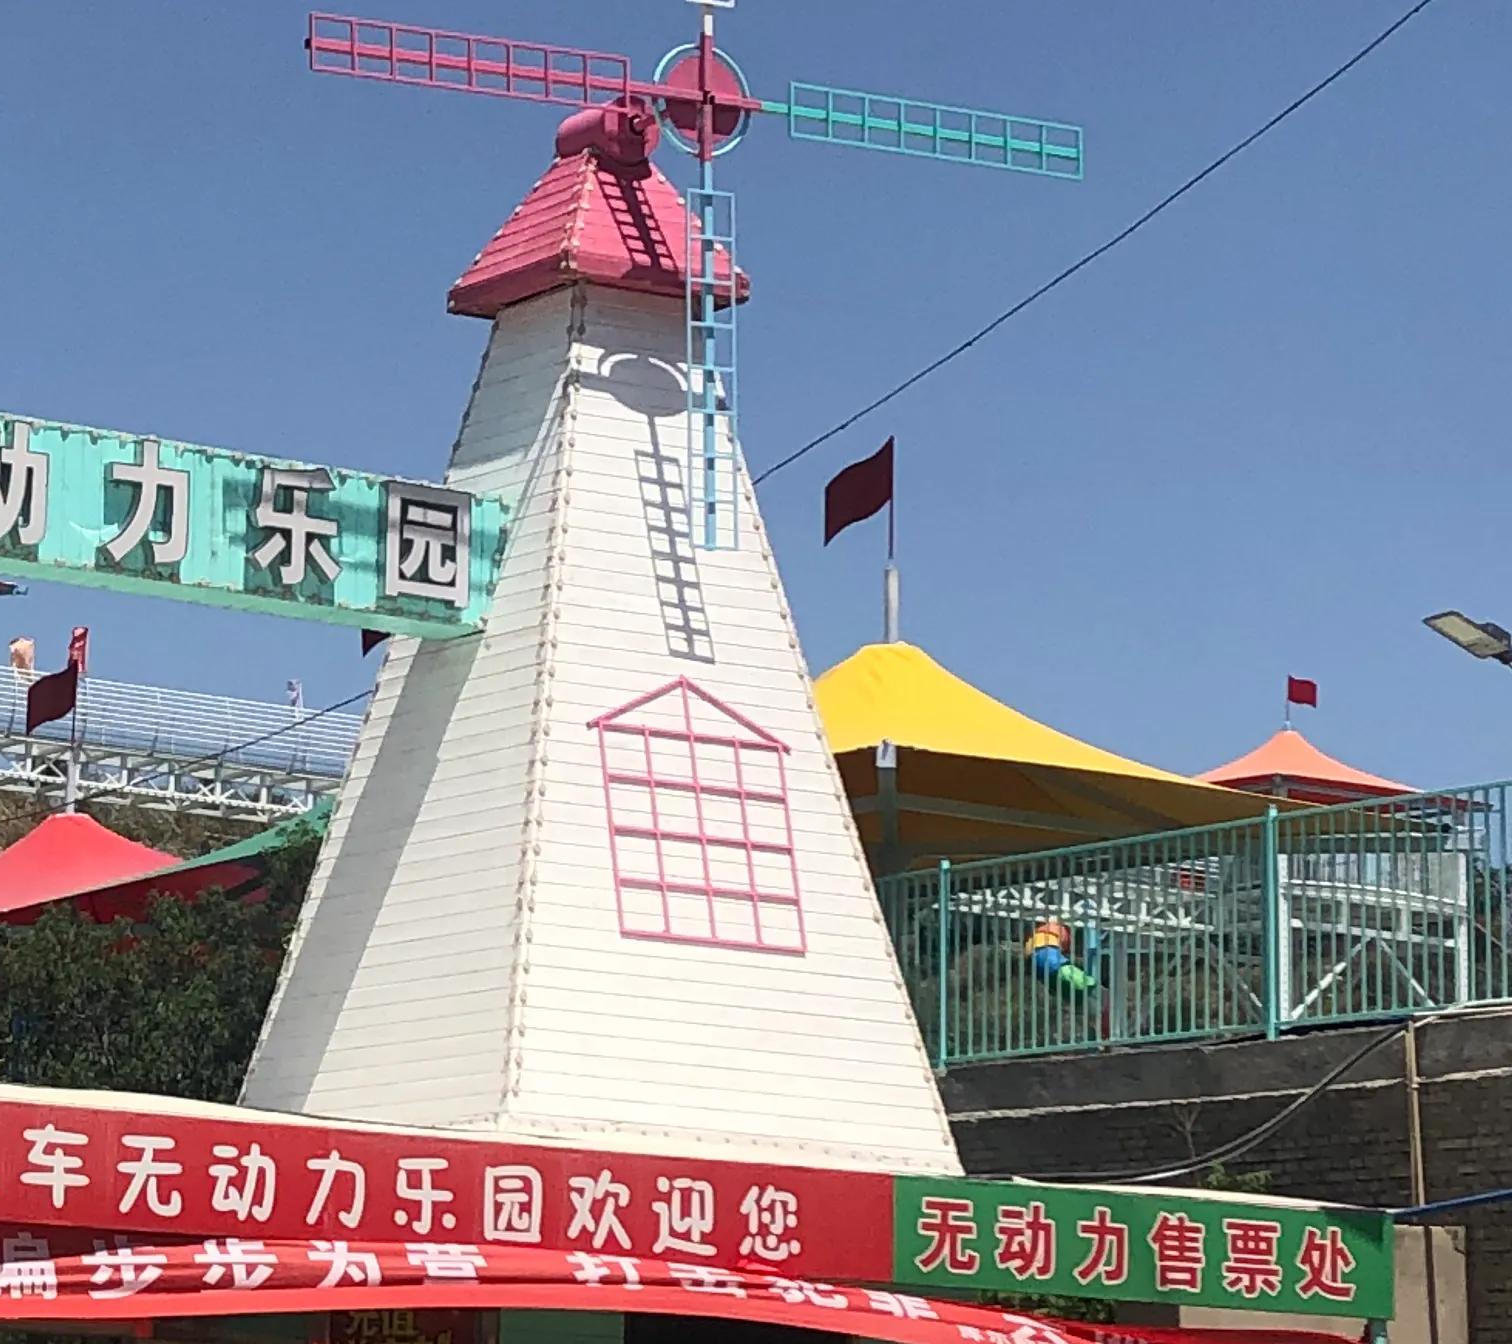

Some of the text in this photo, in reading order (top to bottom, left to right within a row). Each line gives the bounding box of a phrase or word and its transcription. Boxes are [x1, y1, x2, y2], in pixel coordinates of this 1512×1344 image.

[915, 1196, 1359, 1302] 无动力售票处
